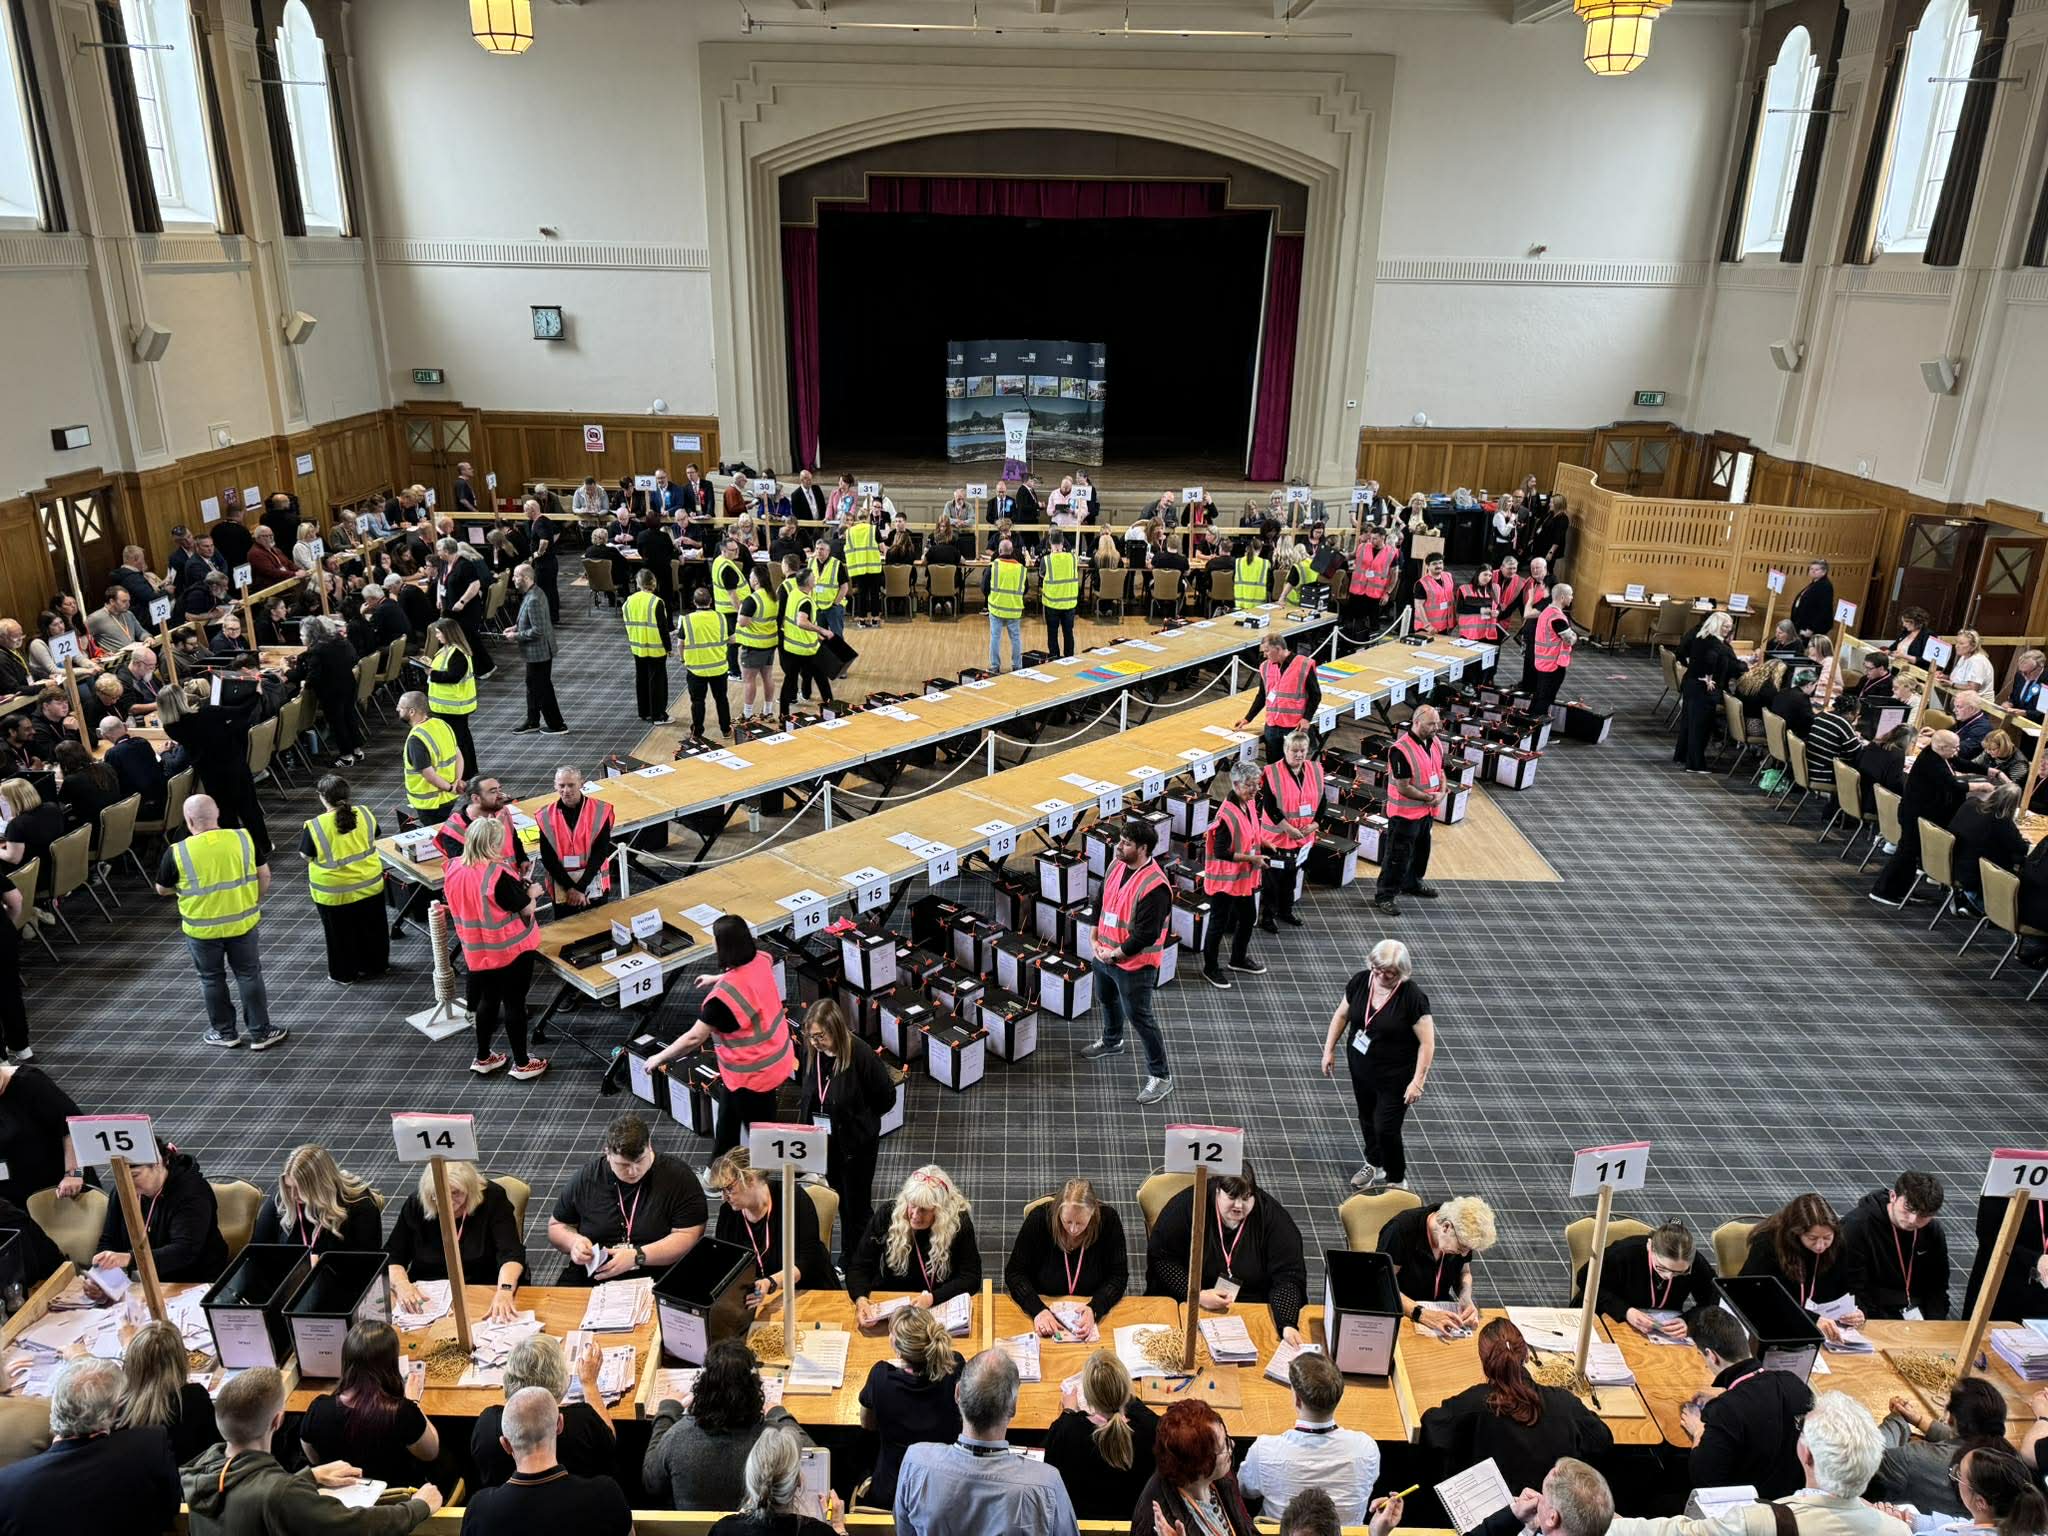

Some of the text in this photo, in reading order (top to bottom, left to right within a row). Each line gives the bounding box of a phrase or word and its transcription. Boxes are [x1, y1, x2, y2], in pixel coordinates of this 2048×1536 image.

[640, 479, 651, 487] 29
[759, 483, 770, 491] 30
[863, 485, 873, 493] 31
[971, 487, 982, 495] 32
[1076, 489, 1087, 497] 33
[1292, 490, 1303, 498] 35
[1187, 491, 1198, 499] 34
[1356, 492, 1368, 500] 36
[239, 569, 248, 582] 24
[156, 604, 167, 617] 23
[1842, 608, 1848, 618] 2
[58, 640, 72, 655] 22
[1933, 646, 1941, 658] 3
[1360, 703, 1366, 713] 5
[1325, 716, 1331, 726] 6
[706, 752, 723, 760] 23
[645, 766, 663, 774] 22
[1201, 763, 1207, 774] 9
[1149, 781, 1159, 793] 10
[1044, 802, 1062, 810] 12
[1105, 797, 1116, 810] 11
[985, 823, 1003, 832] 13
[1056, 815, 1068, 829] 12
[404, 831, 425, 839] 19
[924, 845, 943, 855] 14
[997, 838, 1010, 851] 13
[936, 861, 950, 876] 14
[855, 871, 874, 881] 15
[791, 894, 812, 905] 16
[867, 887, 882, 902] 15
[804, 911, 820, 927] 16
[620, 958, 644, 970] 18
[632, 977, 652, 995] 18
[94, 1129, 134, 1152] 15
[416, 1129, 455, 1150] 14
[771, 1139, 808, 1160] 13
[1188, 1141, 1223, 1163] 12
[1595, 1159, 1628, 1182] 11
[2013, 1163, 2048, 1187] 10
